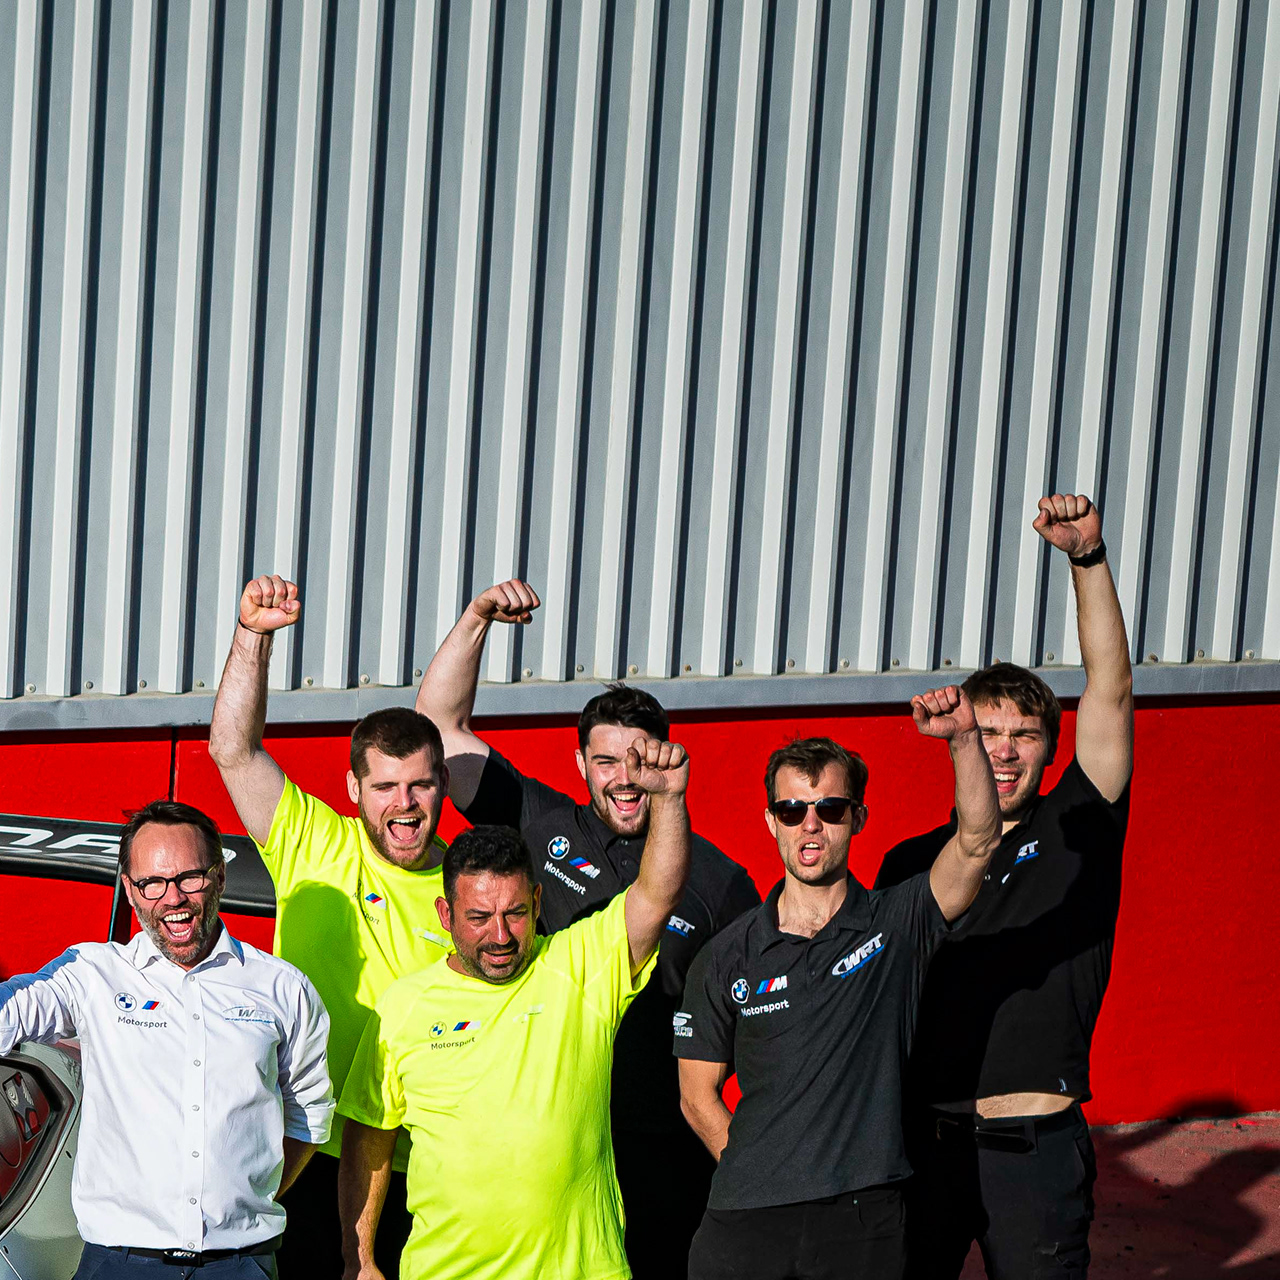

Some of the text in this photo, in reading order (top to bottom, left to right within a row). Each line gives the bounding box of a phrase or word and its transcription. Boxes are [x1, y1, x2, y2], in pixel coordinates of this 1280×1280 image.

[544, 860, 587, 896] Motorsport
[668, 915, 696, 933] RT
[843, 932, 884, 972] WRT
[740, 999, 790, 1018] Motorsport
[117, 1015, 168, 1029] Motorsport
[430, 1036, 476, 1051] Motorsport
